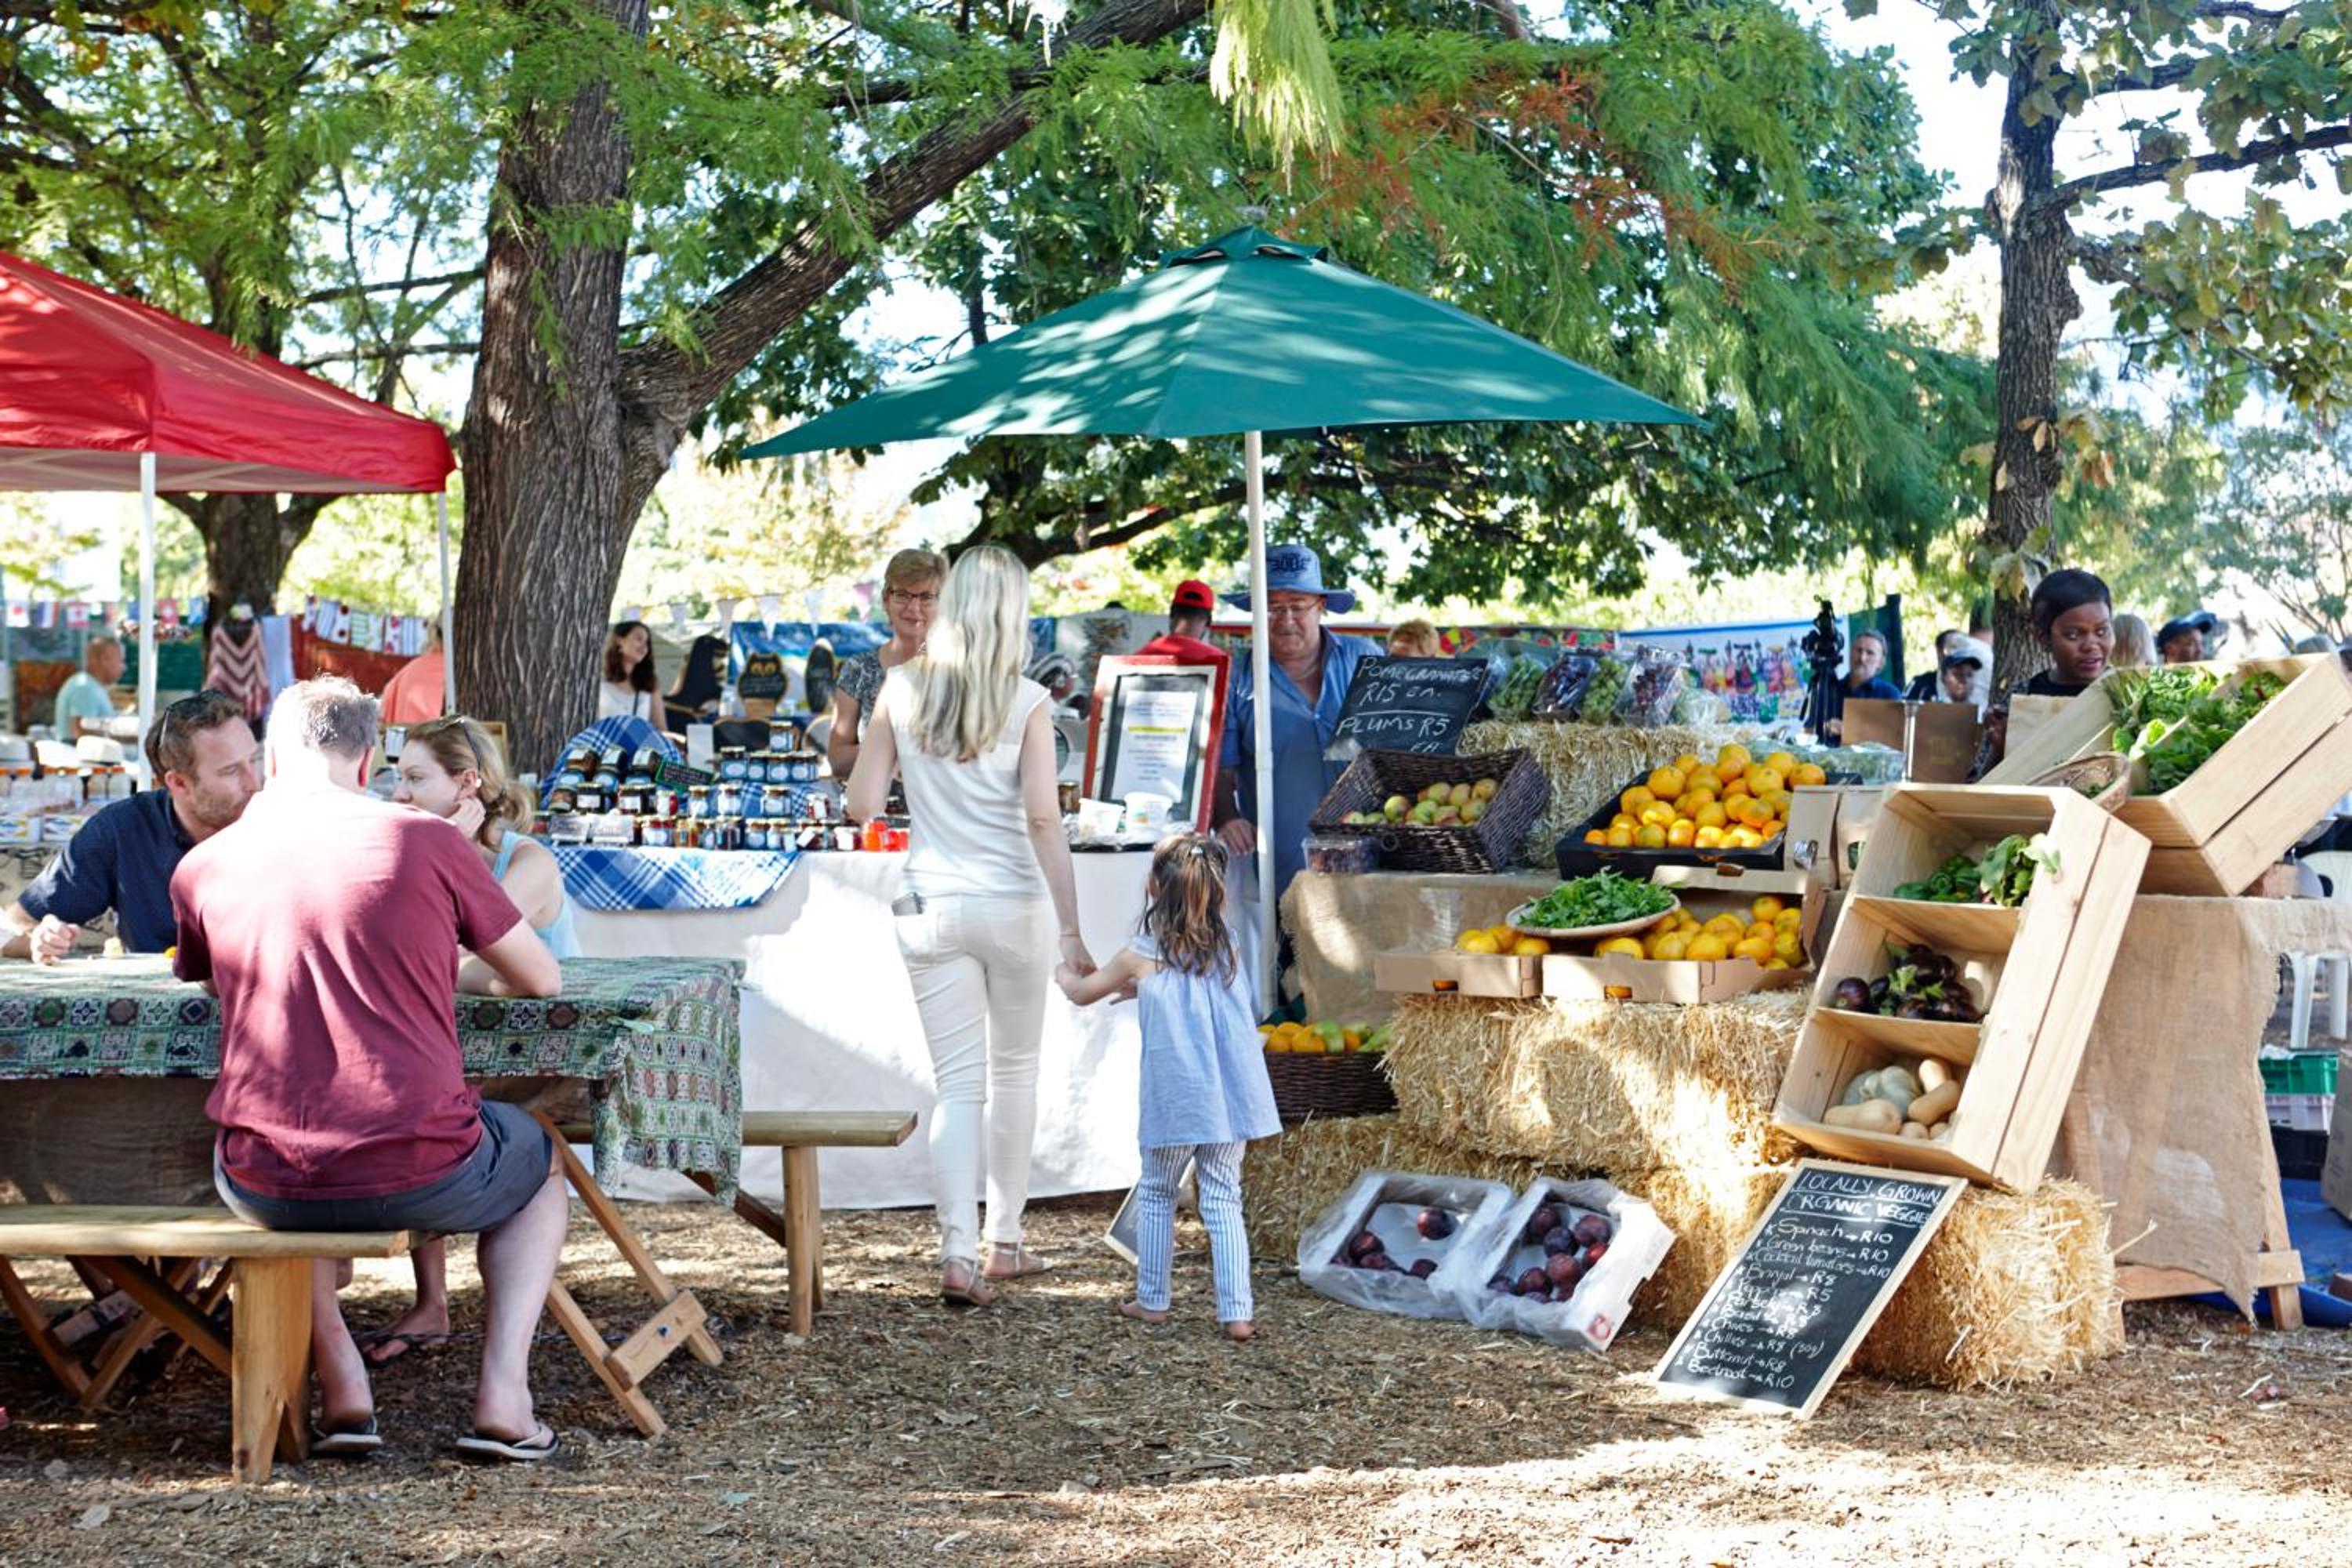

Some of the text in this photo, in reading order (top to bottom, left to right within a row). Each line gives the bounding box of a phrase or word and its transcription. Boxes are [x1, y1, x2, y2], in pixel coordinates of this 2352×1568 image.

[1359, 681, 1402, 706] R15
[1336, 717, 1450, 738] PLUMS R5
[1796, 1171, 1940, 1203] LOCALLY GROWN
[1787, 1192, 1871, 1215] ORGANIC
[1777, 1218, 1893, 1244] Spinach R10
[1766, 1234, 1889, 1262] Green beans R10
[1867, 1265, 1890, 1279] R10
[1806, 1287, 1835, 1301] R5
[1765, 1374, 1795, 1388] R10
